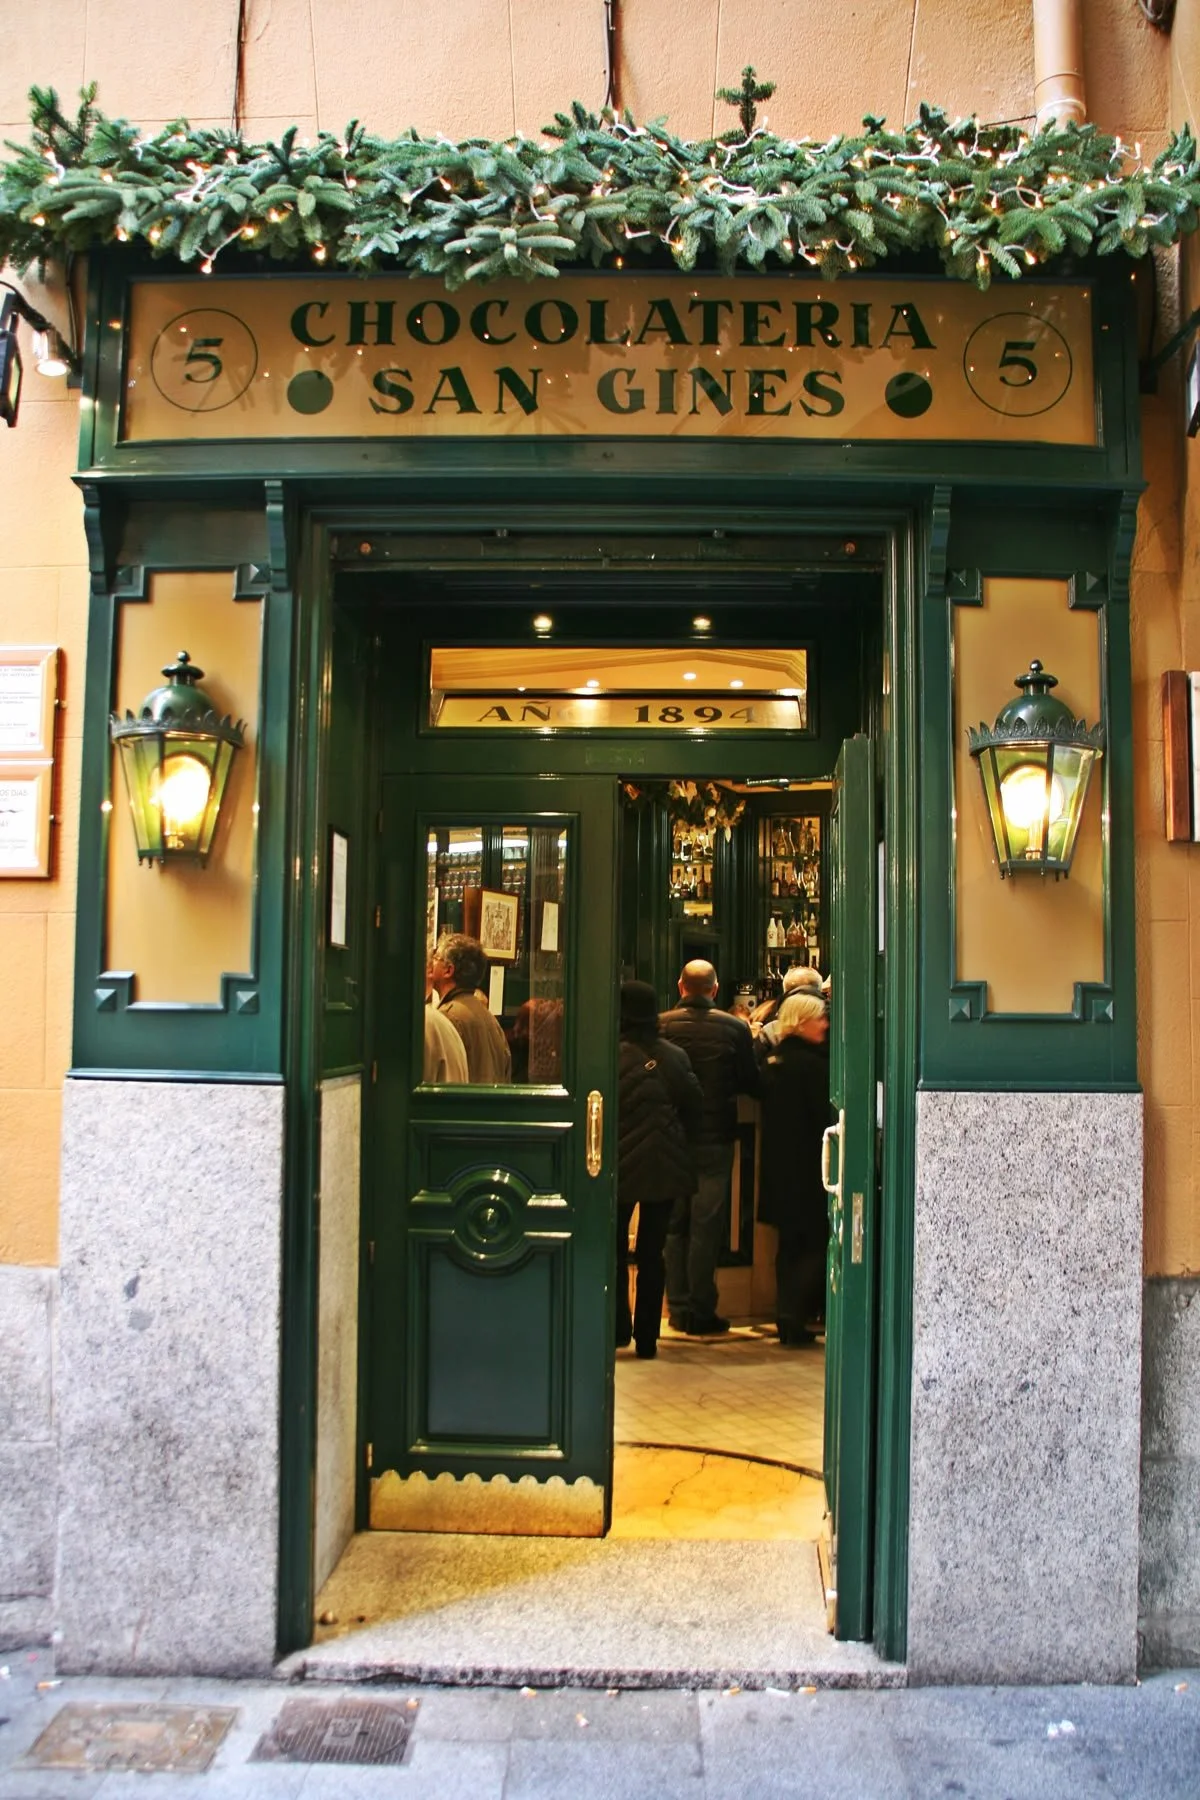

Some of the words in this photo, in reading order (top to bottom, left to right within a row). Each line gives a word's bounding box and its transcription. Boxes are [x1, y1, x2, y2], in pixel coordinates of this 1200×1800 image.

[290, 298, 937, 350] CHOCOLATERIA
[185, 338, 224, 383] 5
[999, 341, 1037, 387] 5
[368, 366, 543, 416] SAN
[596, 366, 845, 418] GINES
[476, 700, 583, 722] AÑ
[634, 705, 759, 724] 1894
